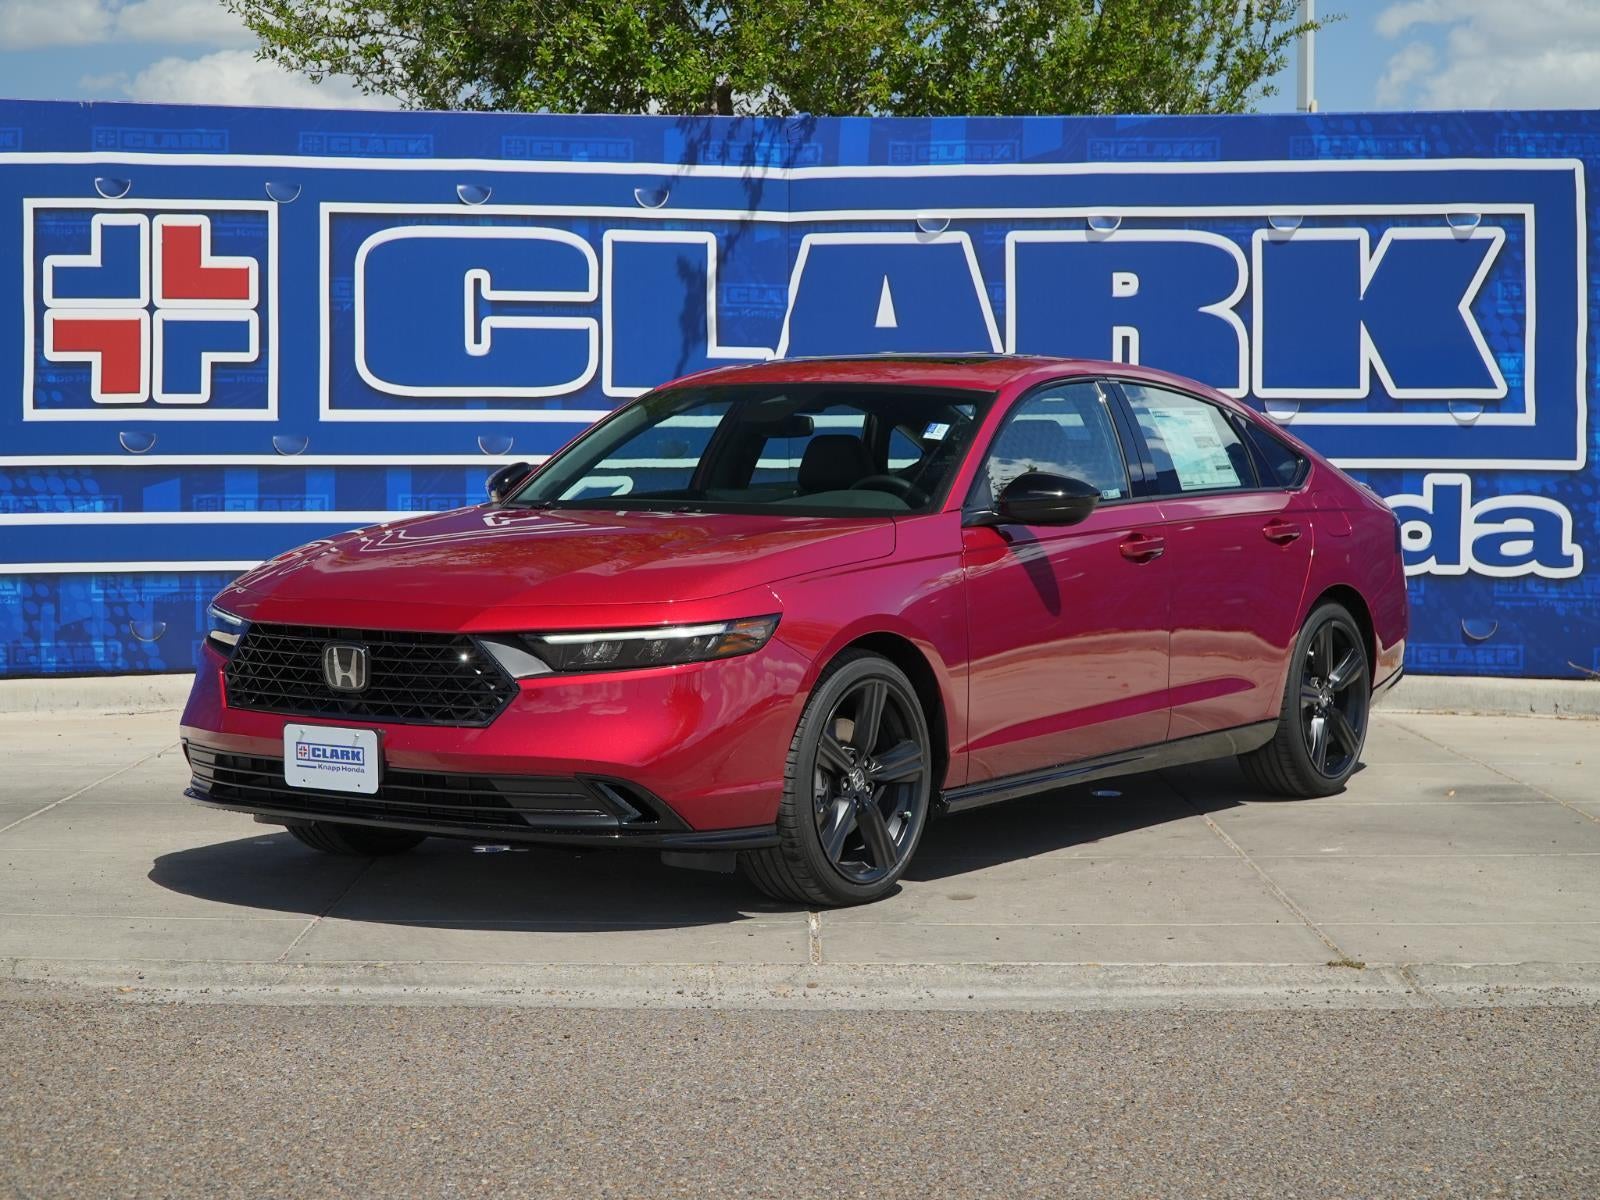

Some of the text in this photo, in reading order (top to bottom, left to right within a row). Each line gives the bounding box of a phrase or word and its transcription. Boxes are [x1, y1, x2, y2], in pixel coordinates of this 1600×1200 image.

[354, 225, 1507, 400] CLARK
[1384, 473, 1583, 578] da
[311, 747, 362, 762] CLARK
[317, 763, 365, 774] Knapp Honda
